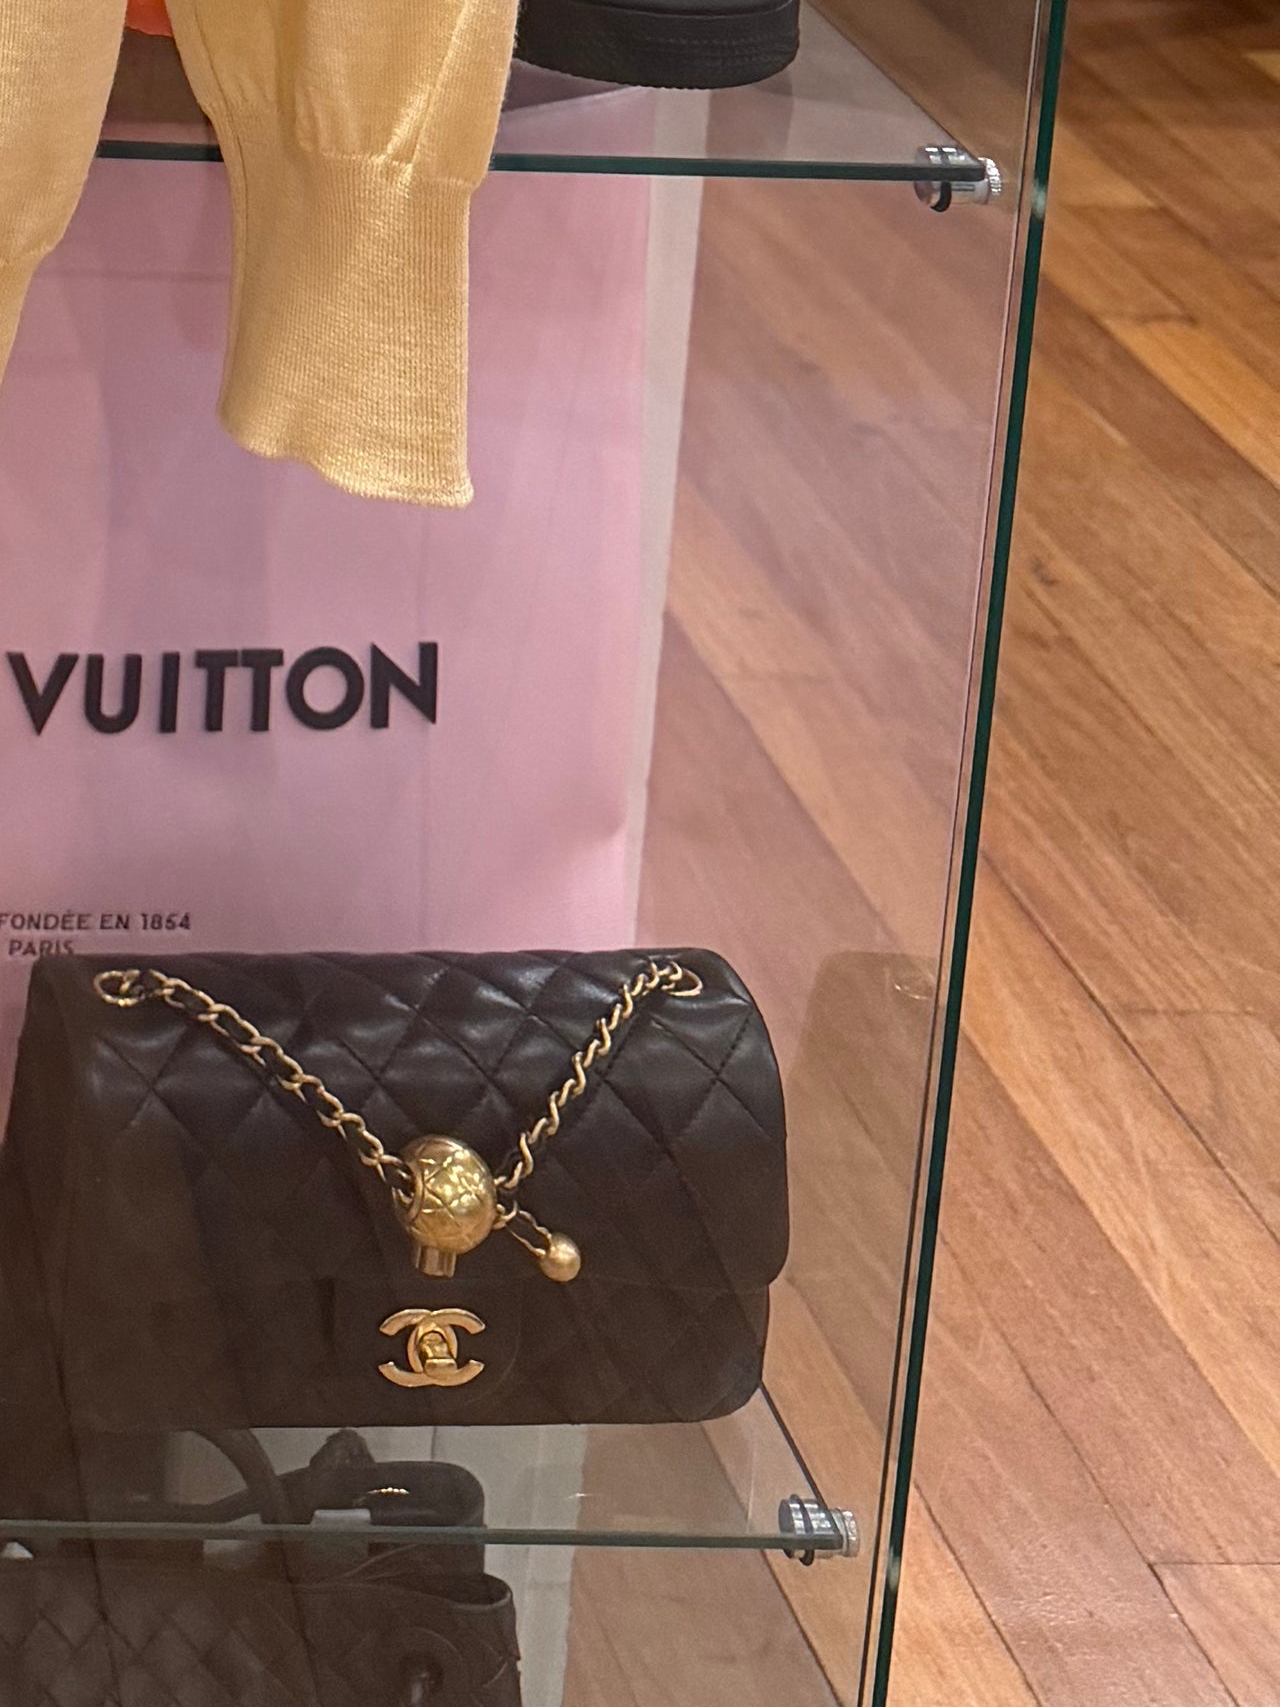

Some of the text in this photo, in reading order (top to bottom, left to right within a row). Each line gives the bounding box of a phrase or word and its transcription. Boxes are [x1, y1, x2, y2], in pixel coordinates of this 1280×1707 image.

[7, 641, 438, 737] VUITTON
[99, 913, 130, 930] EN
[9, 939, 74, 956] PARIS
